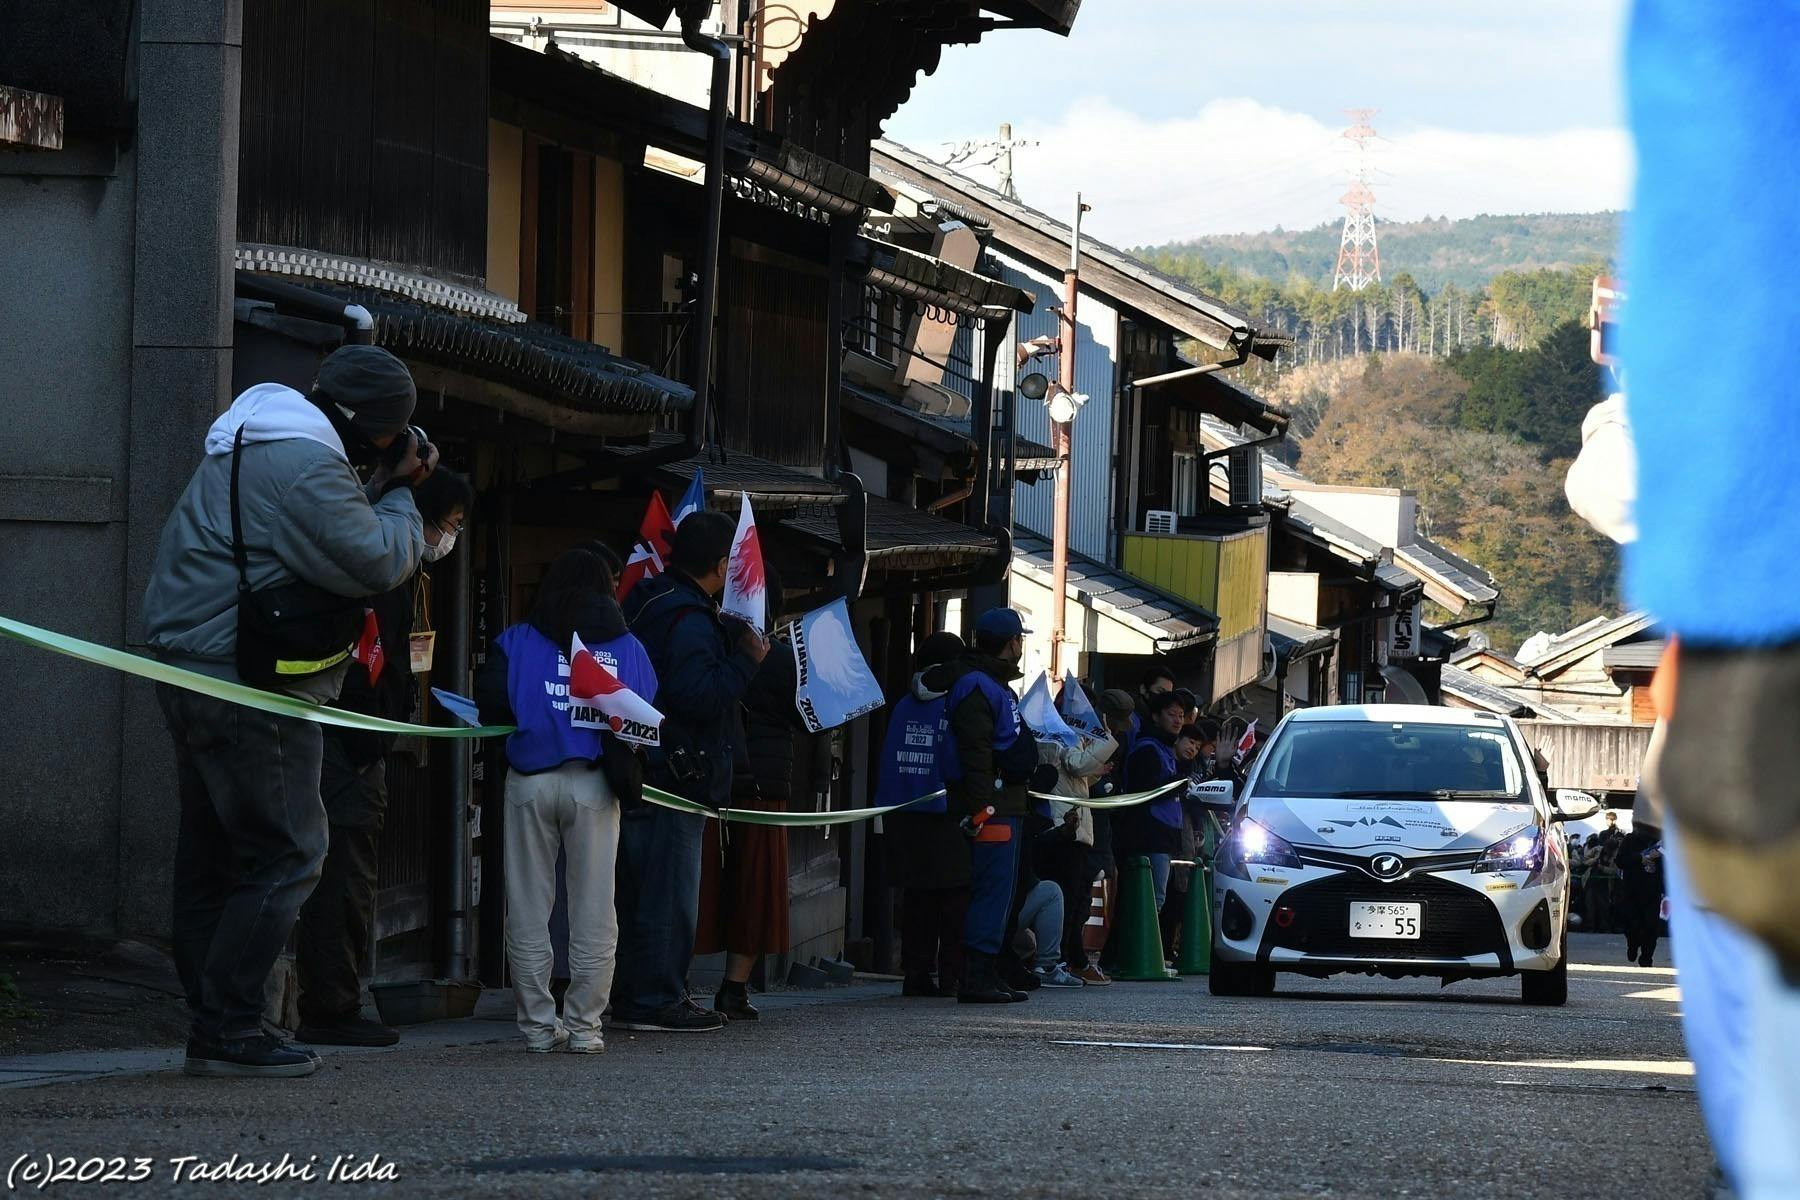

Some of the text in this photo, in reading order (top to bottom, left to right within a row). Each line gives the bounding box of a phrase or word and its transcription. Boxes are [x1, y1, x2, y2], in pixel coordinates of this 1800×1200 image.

[800, 697, 824, 731] 2023
[621, 718, 659, 741] 2023
[1367, 905, 1406, 916] 多摩 565
[1394, 917, 1417, 936] 55
